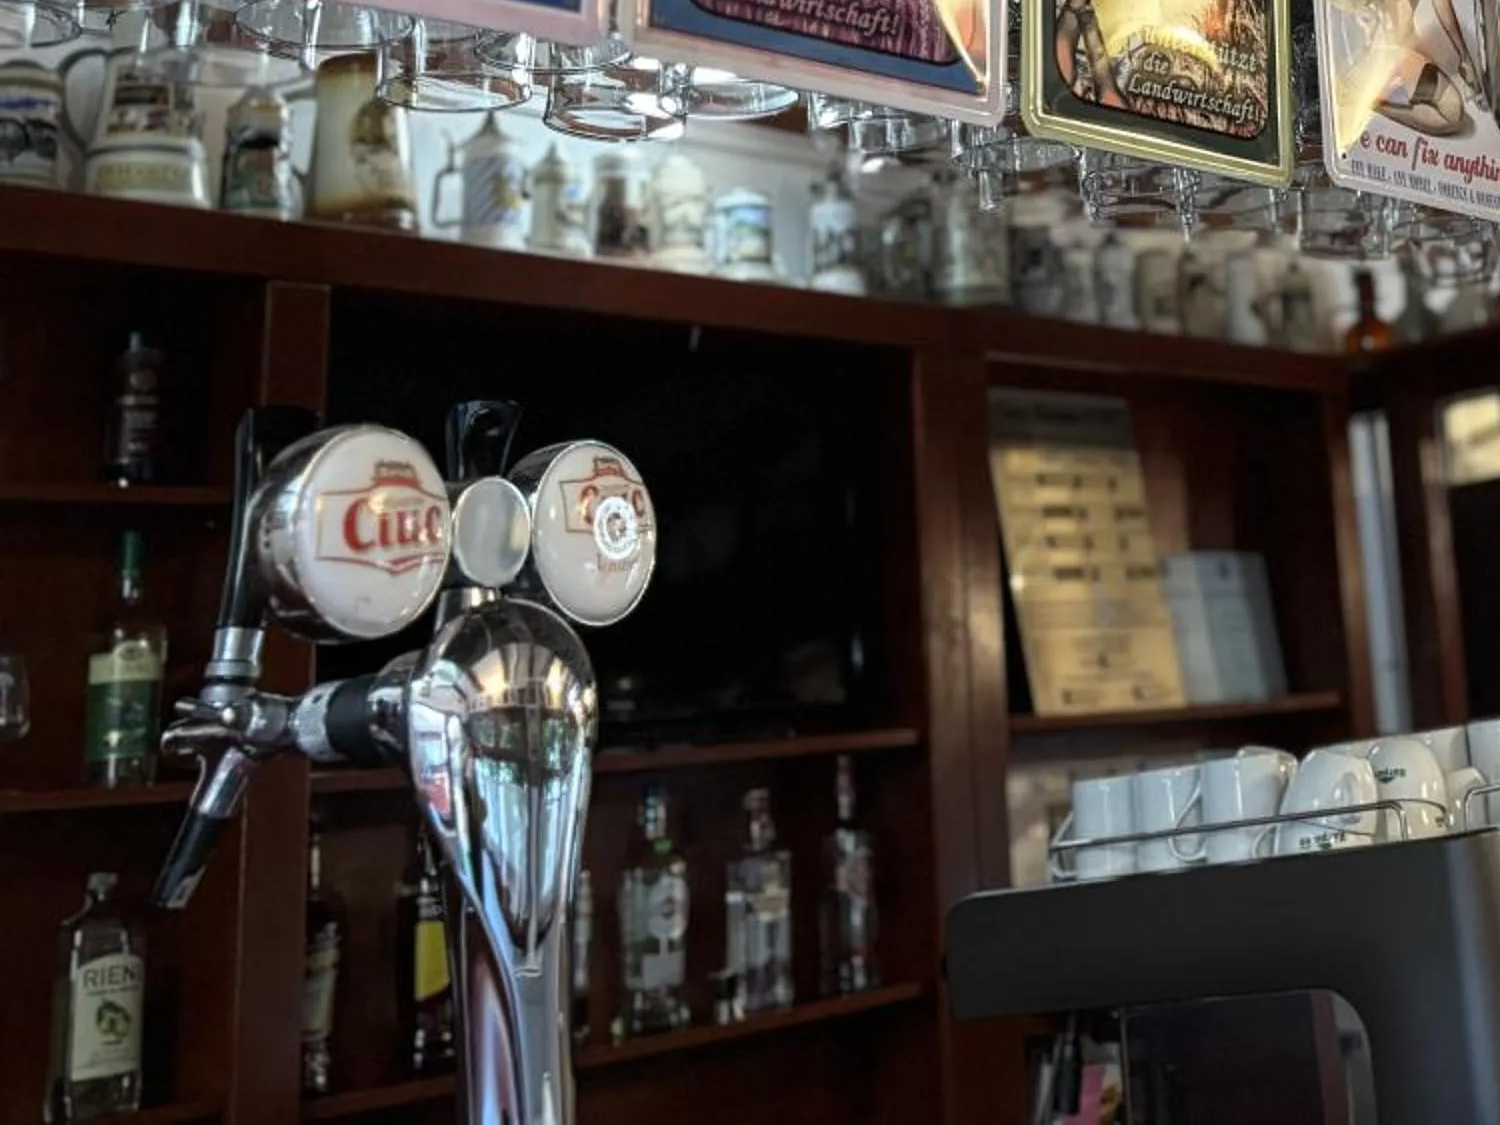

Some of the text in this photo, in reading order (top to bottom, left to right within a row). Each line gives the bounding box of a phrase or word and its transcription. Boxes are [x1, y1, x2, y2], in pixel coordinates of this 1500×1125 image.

[1143, 49, 1170, 74] die
[1127, 74, 1260, 124] Landwirtschaft!
[1375, 133, 1408, 159] can
[1411, 135, 1440, 172] fix
